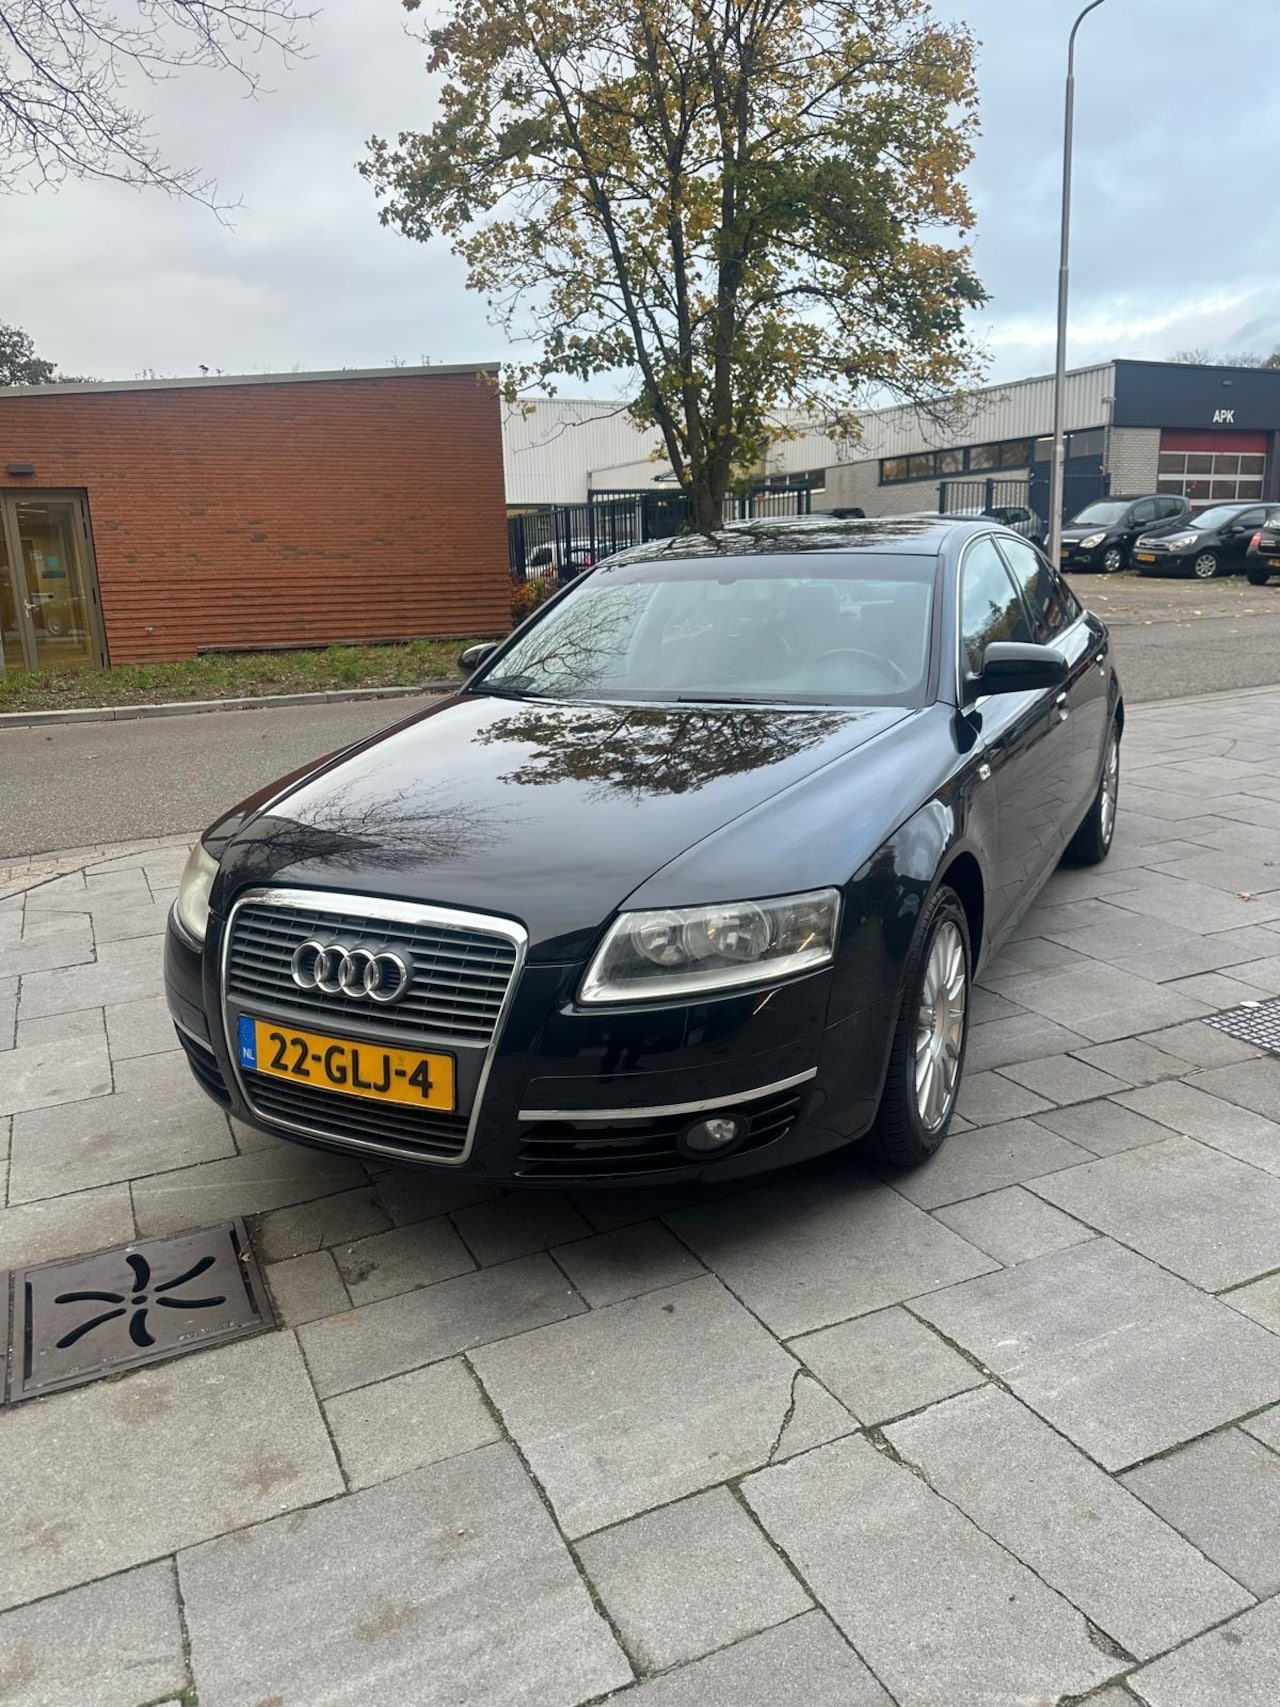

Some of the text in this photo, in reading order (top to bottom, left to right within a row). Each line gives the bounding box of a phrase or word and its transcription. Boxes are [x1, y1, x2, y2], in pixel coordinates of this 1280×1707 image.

[1212, 409, 1235, 423] APK
[242, 1047, 255, 1060] NL
[269, 1032, 433, 1098] 22-GLJ-4
